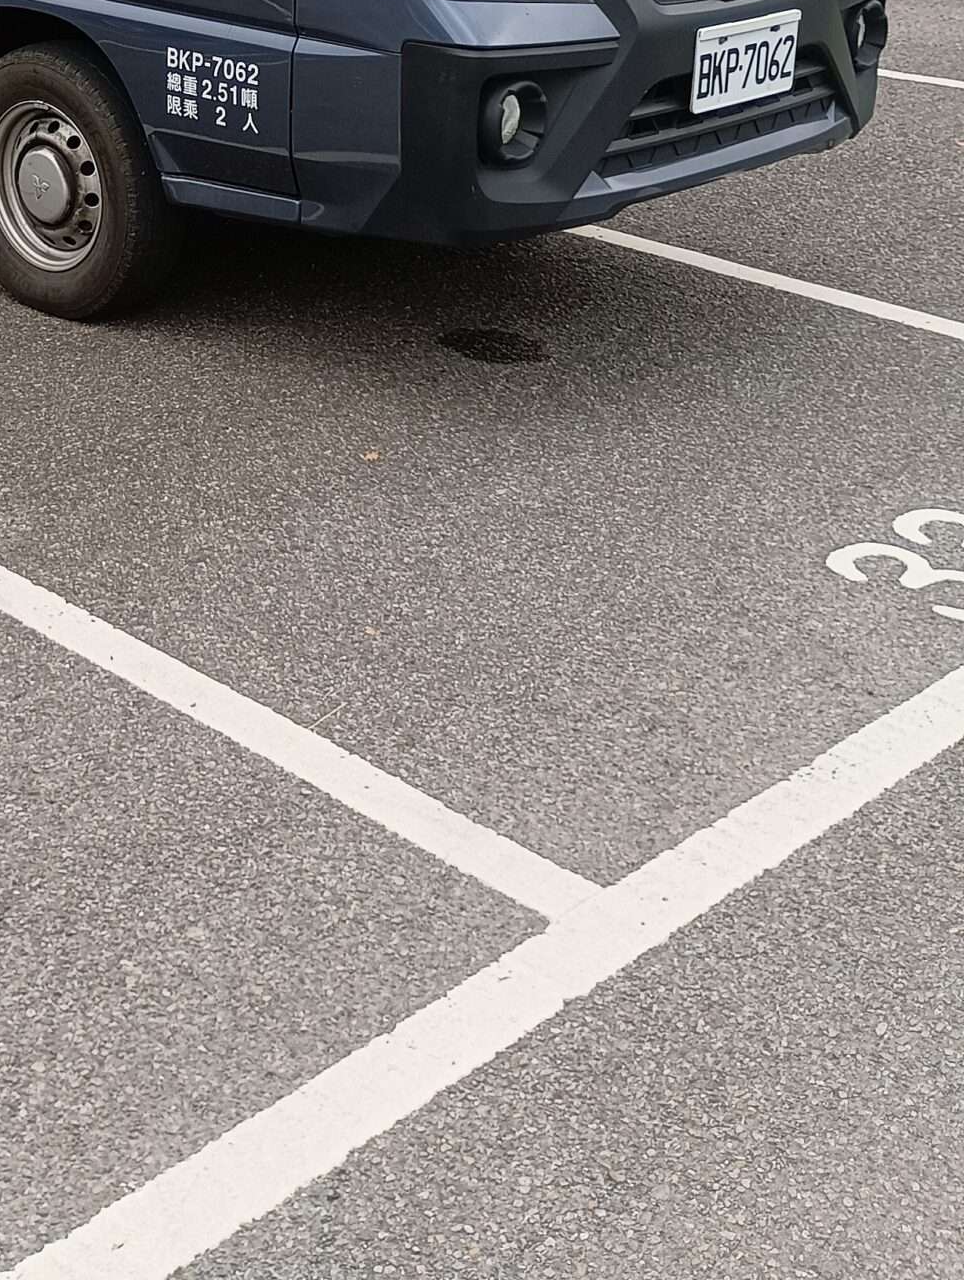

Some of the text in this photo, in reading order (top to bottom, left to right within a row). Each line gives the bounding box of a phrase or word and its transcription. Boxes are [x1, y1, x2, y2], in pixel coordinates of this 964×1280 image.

[167, 47, 259, 86] BKP-7062
[696, 34, 795, 100] BKP-7062
[215, 106, 227, 127] 2
[242, 112, 259, 134] 人
